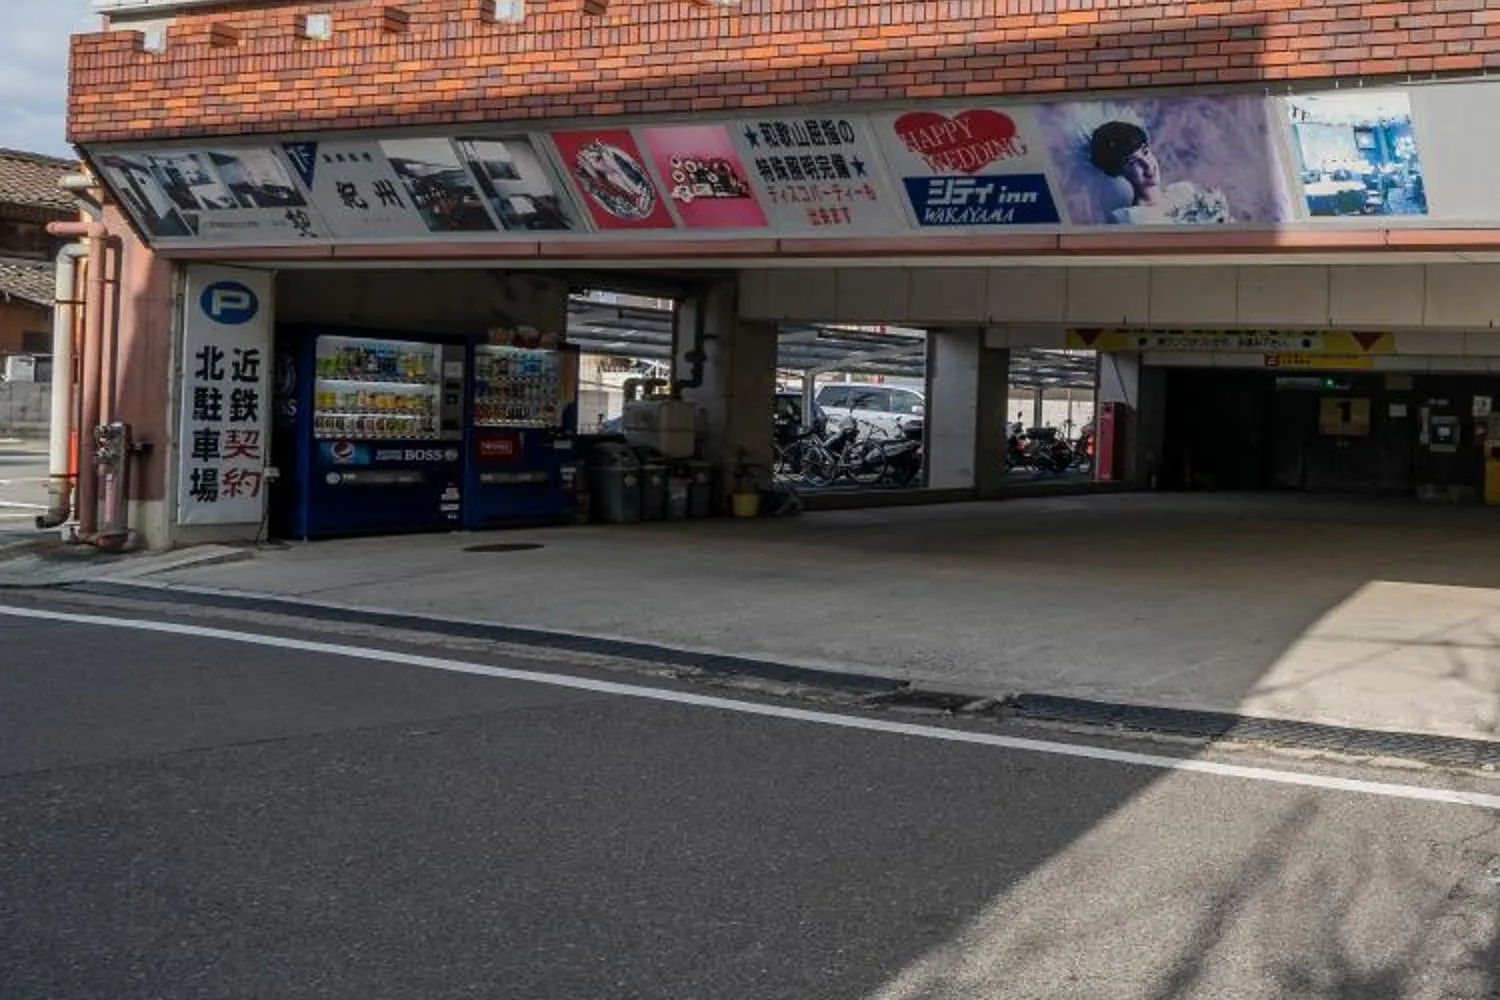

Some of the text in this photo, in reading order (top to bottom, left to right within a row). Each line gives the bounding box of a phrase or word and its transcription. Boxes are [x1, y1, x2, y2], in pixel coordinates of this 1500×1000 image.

[901, 117, 973, 152] HAPPY
[922, 136, 1027, 174] WEDDING
[1000, 186, 1038, 203] inn
[924, 207, 1015, 224] WAKAYAMA
[211, 290, 250, 316] P
[190, 345, 225, 503] 北駐車場
[221, 348, 261, 498] 近鉄契約
[405, 449, 443, 461] BOSS
